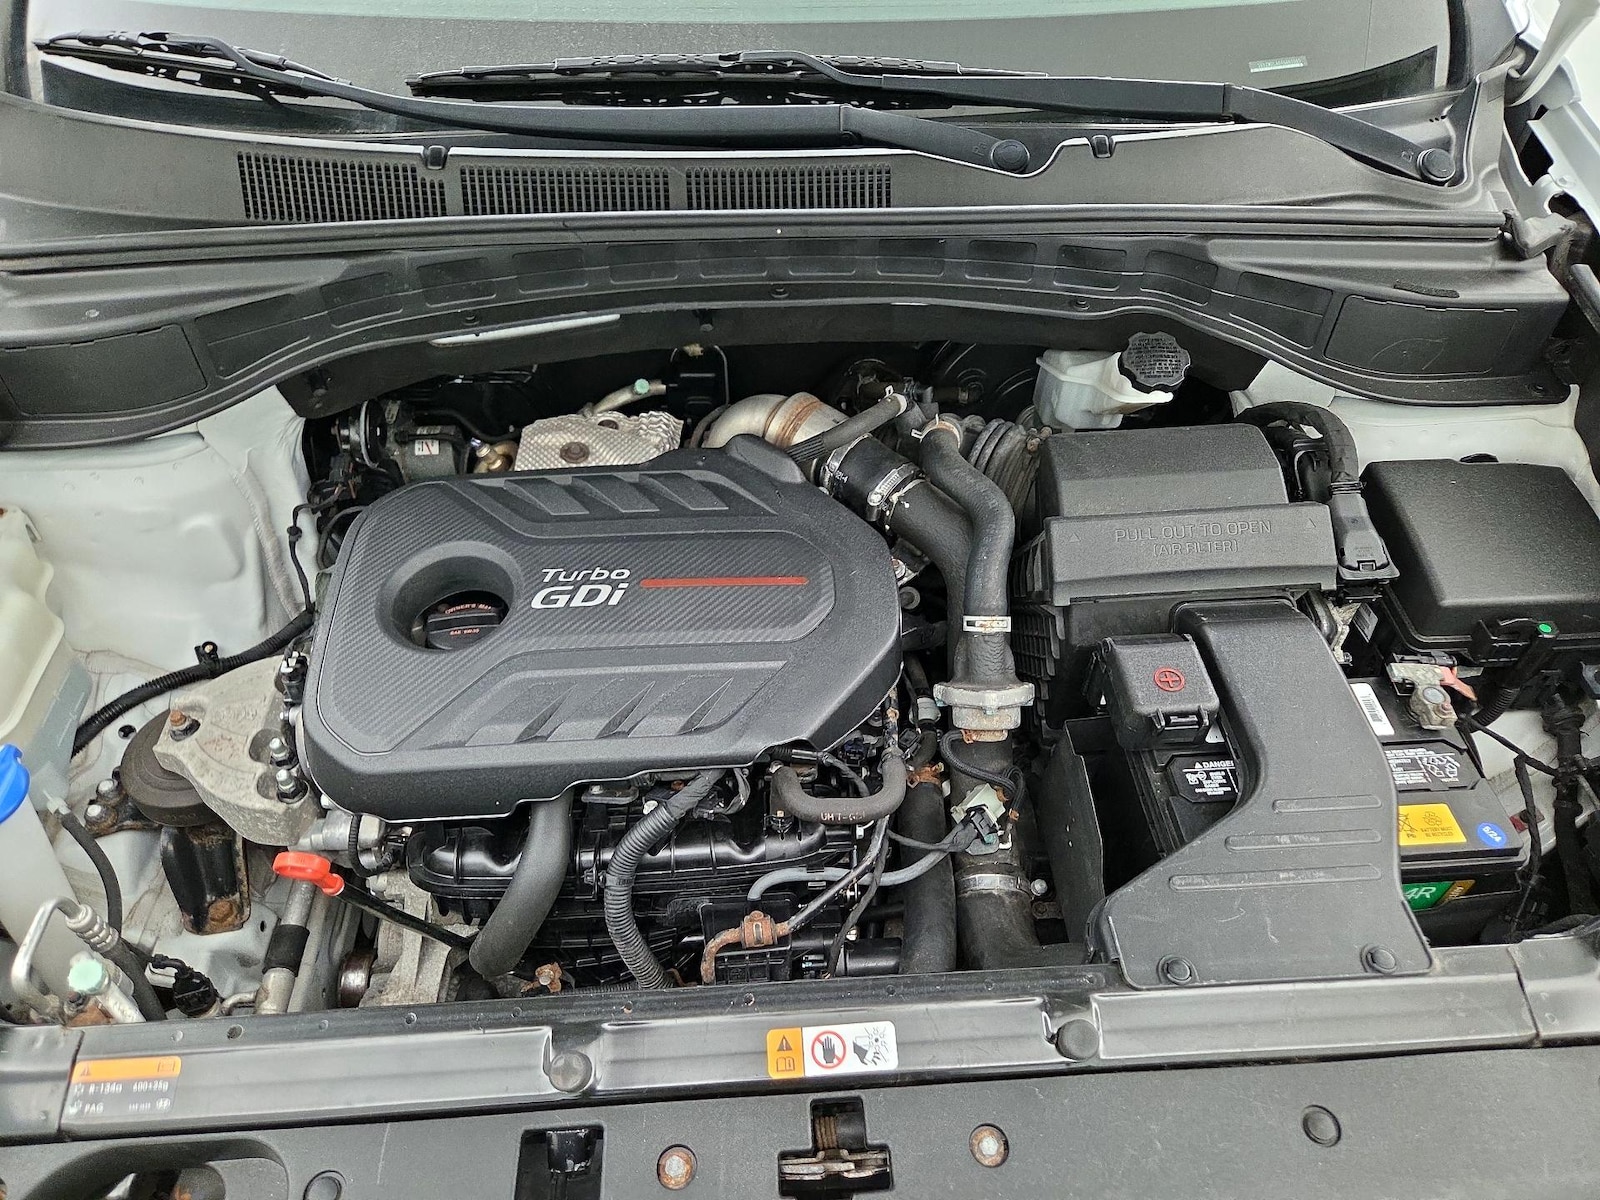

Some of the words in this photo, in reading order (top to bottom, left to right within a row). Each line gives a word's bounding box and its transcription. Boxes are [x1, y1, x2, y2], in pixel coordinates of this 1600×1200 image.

[1115, 528, 1157, 542] PULL
[1161, 524, 1195, 539] OUT
[1200, 522, 1223, 537] TO
[1227, 520, 1272, 535] OPEN
[1153, 543, 1183, 556] (AIR
[1186, 539, 1239, 553] FILTER)
[541, 566, 631, 583] Turbo
[531, 582, 629, 609] GDi
